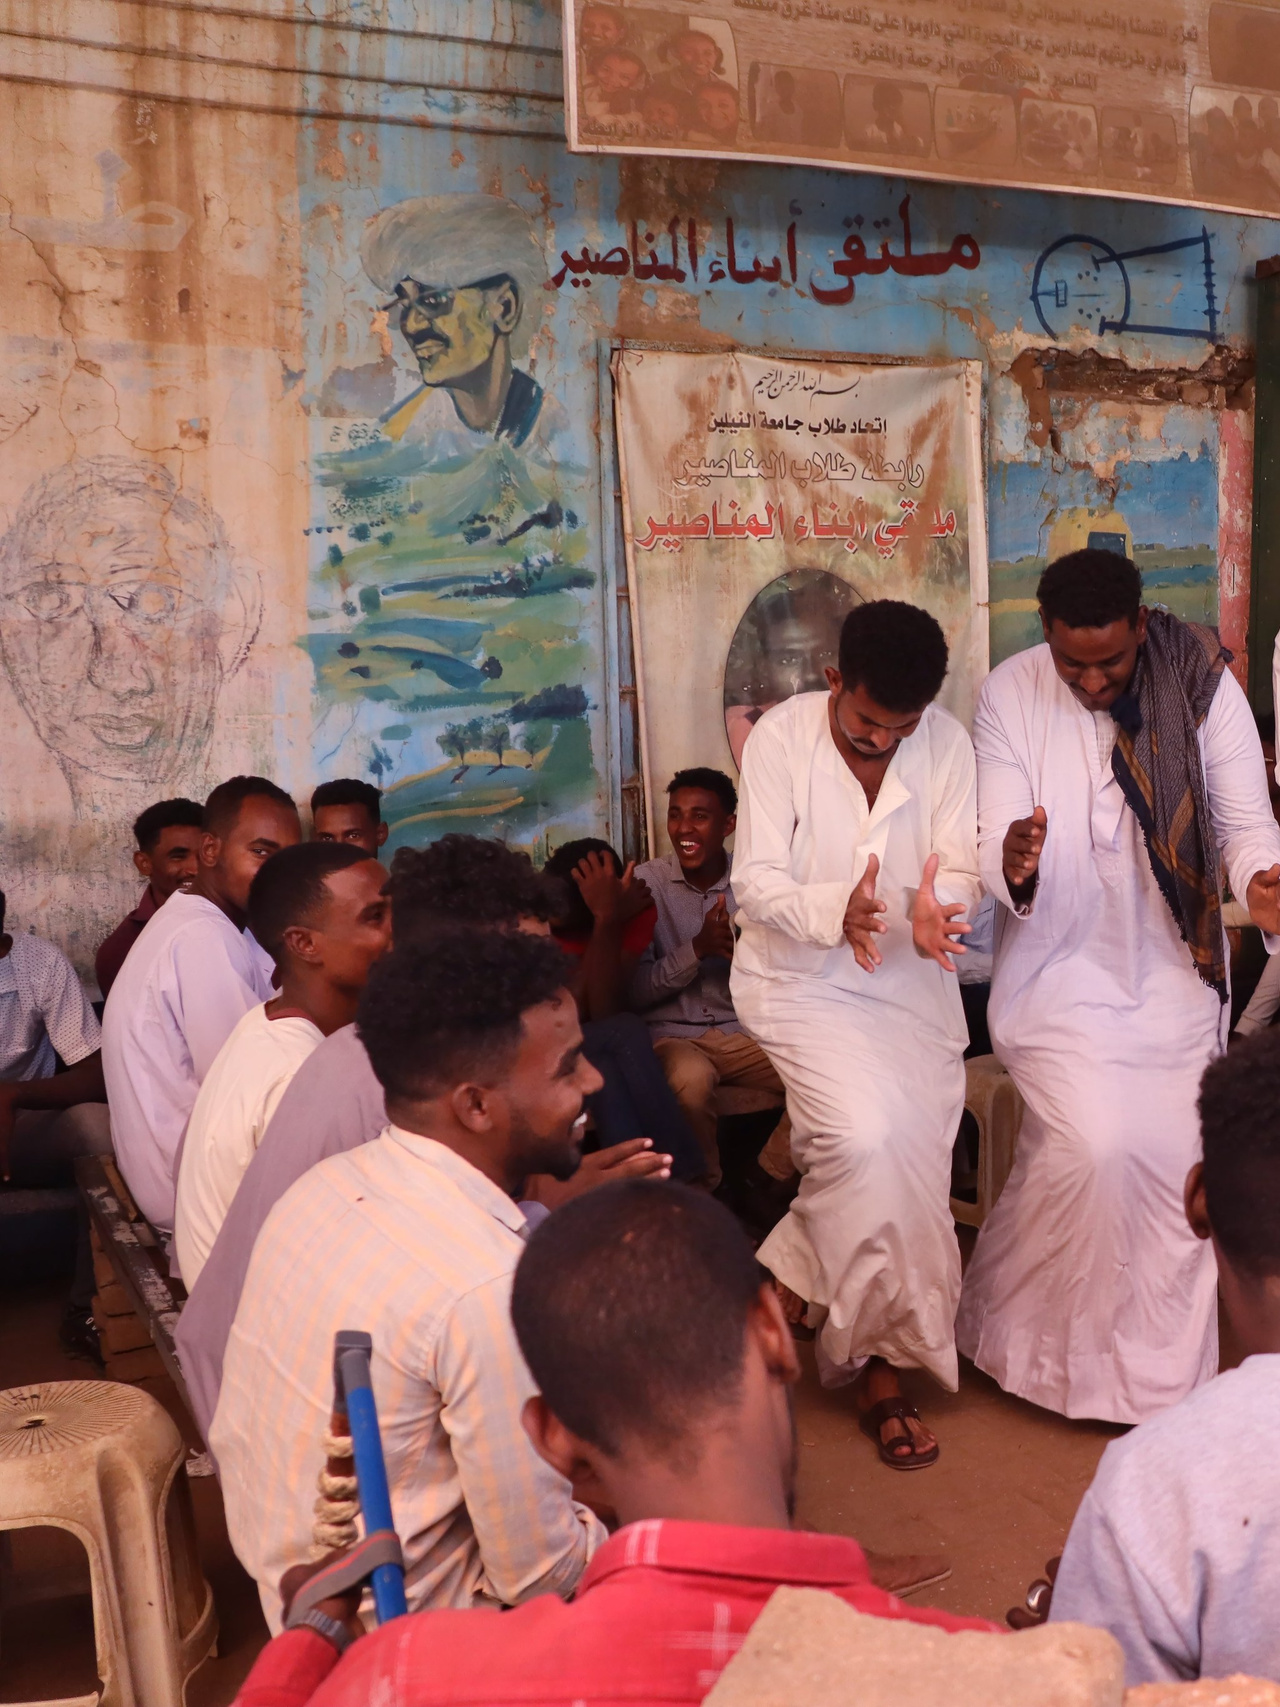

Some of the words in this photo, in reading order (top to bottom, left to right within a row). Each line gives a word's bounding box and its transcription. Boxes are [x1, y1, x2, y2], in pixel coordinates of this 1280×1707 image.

[551, 214, 698, 289] المناصير
[707, 410, 756, 434] النيلين
[760, 410, 804, 436] جامعة
[808, 416, 847, 437] طلاب
[675, 448, 786, 486] المناصير
[790, 451, 857, 489] طلاب
[634, 499, 785, 553] المناصير
